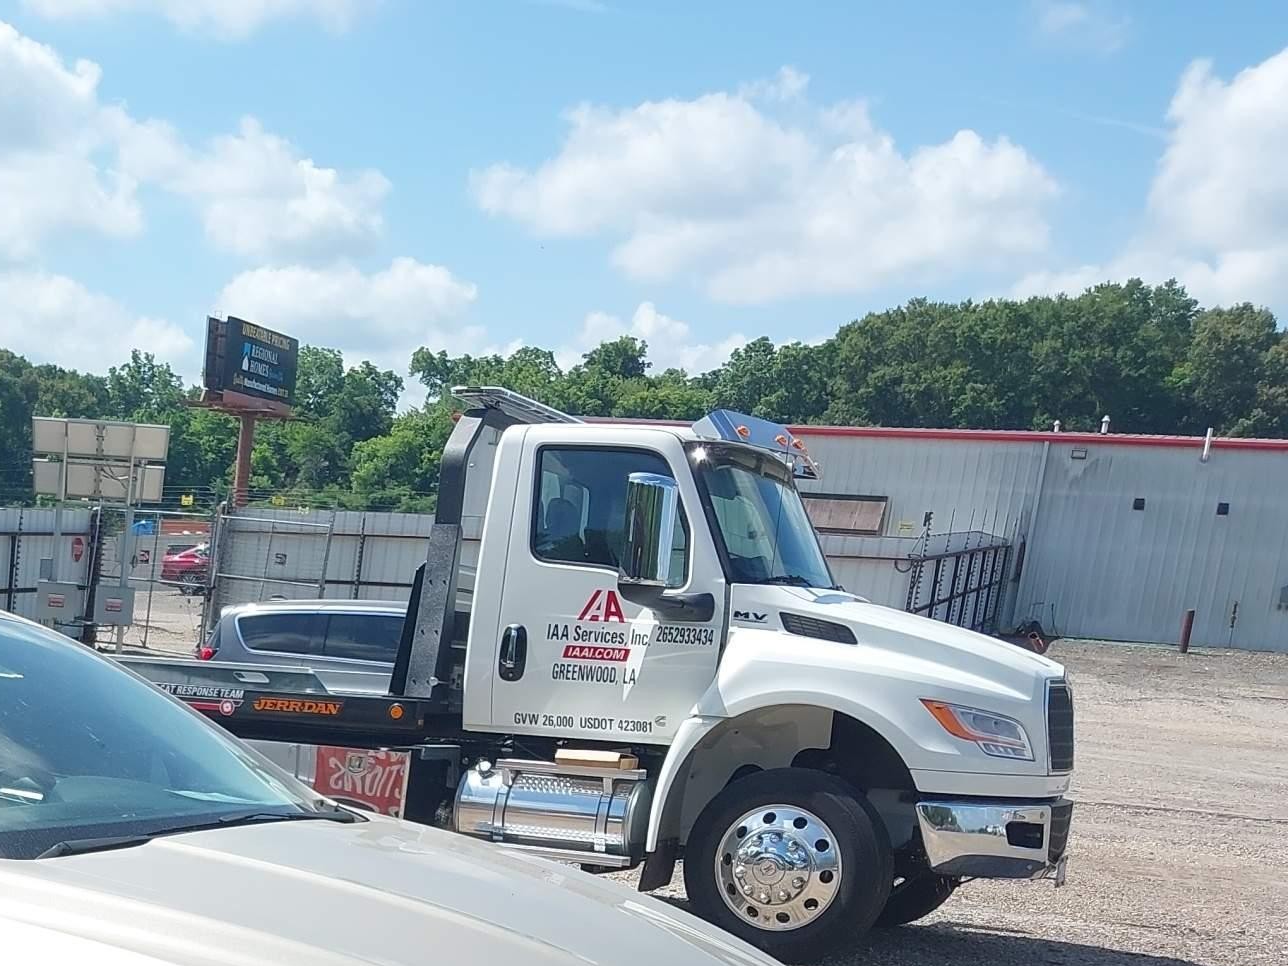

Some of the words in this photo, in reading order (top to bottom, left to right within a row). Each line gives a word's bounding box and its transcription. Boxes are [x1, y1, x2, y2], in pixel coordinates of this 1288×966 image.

[251, 345, 279, 364] REGIONAL
[249, 360, 269, 377] HOMES
[733, 610, 768, 621] MV
[547, 623, 570, 642] IAA
[573, 624, 628, 646] Services,
[655, 626, 715, 646] 2652933434
[567, 646, 626, 660] IAAI.COM
[551, 663, 619, 685] GREENWOOD,
[623, 669, 637, 685] LA
[176, 685, 218, 698] RESPONSE
[219, 687, 244, 699] TEAM
[513, 712, 540, 726] GVW
[542, 714, 574, 728] 26,000
[579, 718, 614, 731] USDOT
[617, 720, 653, 733] 423081
